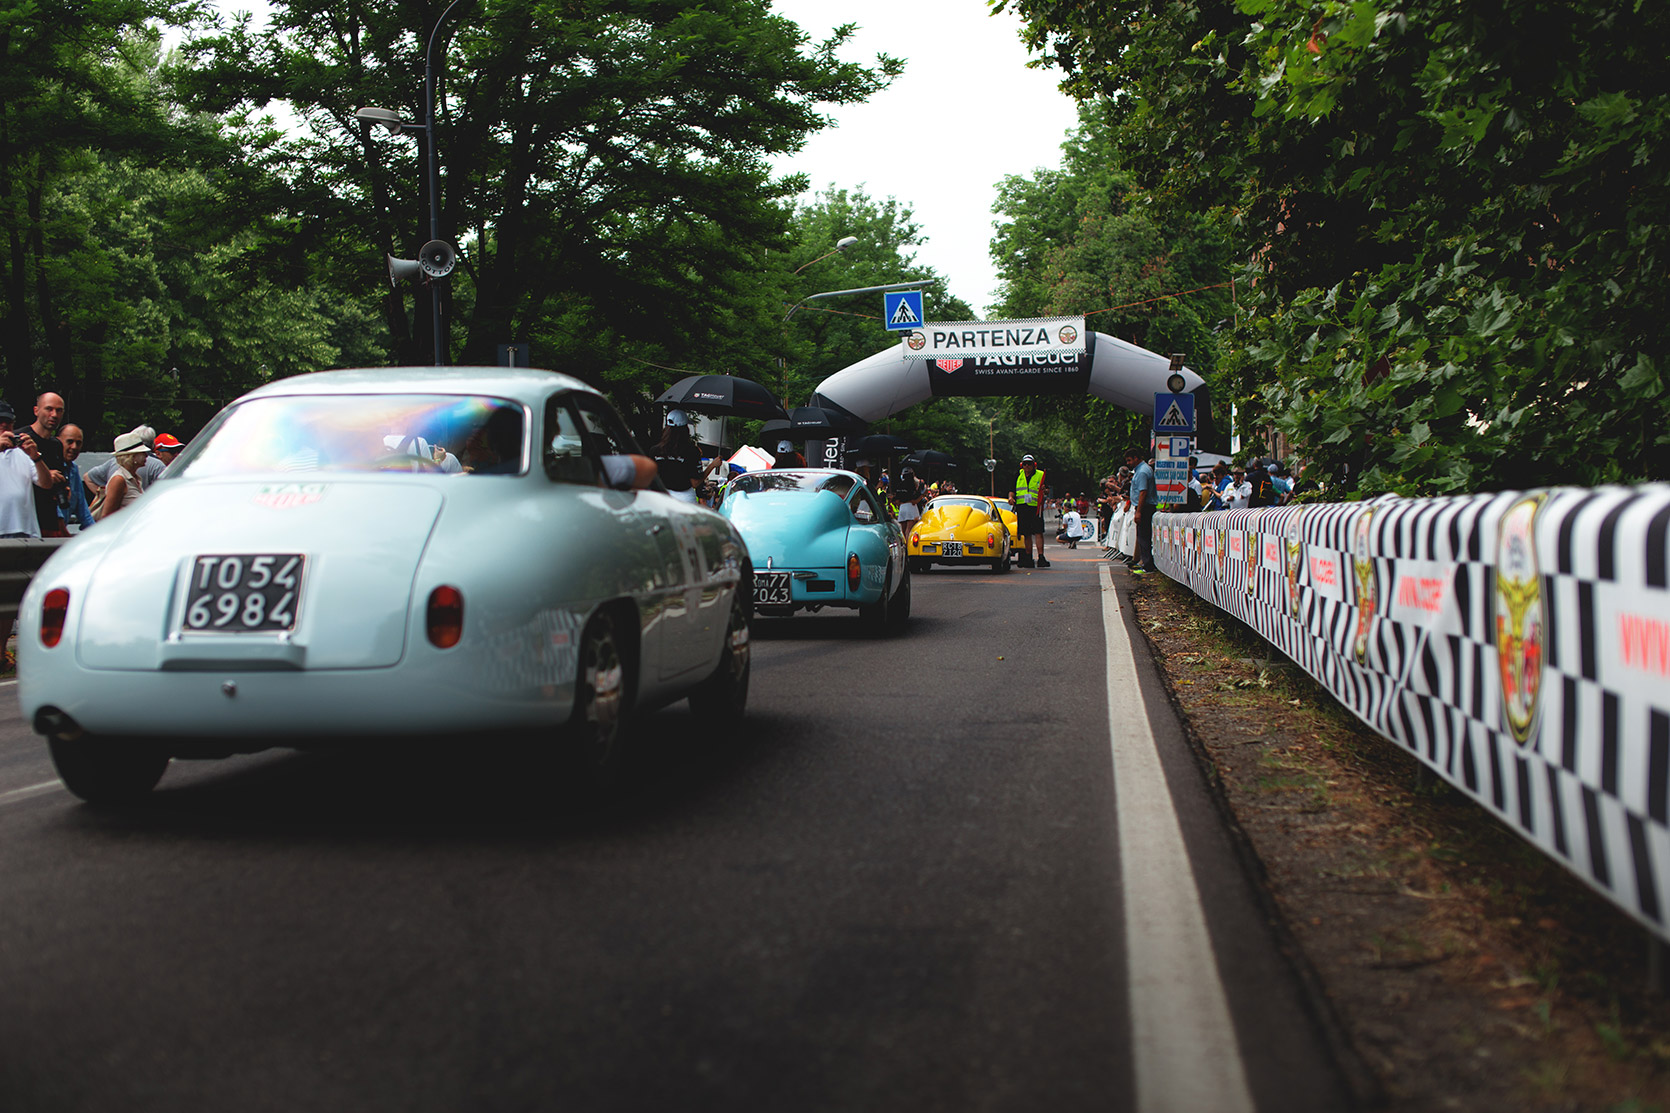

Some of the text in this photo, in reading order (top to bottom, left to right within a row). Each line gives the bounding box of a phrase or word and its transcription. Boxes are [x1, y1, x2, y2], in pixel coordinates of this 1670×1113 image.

[933, 328, 1050, 348] PARTENZA
[935, 359, 963, 371] HEUER
[1172, 438, 1188, 456] P
[770, 574, 788, 587] 77
[187, 592, 294, 628] 6984
